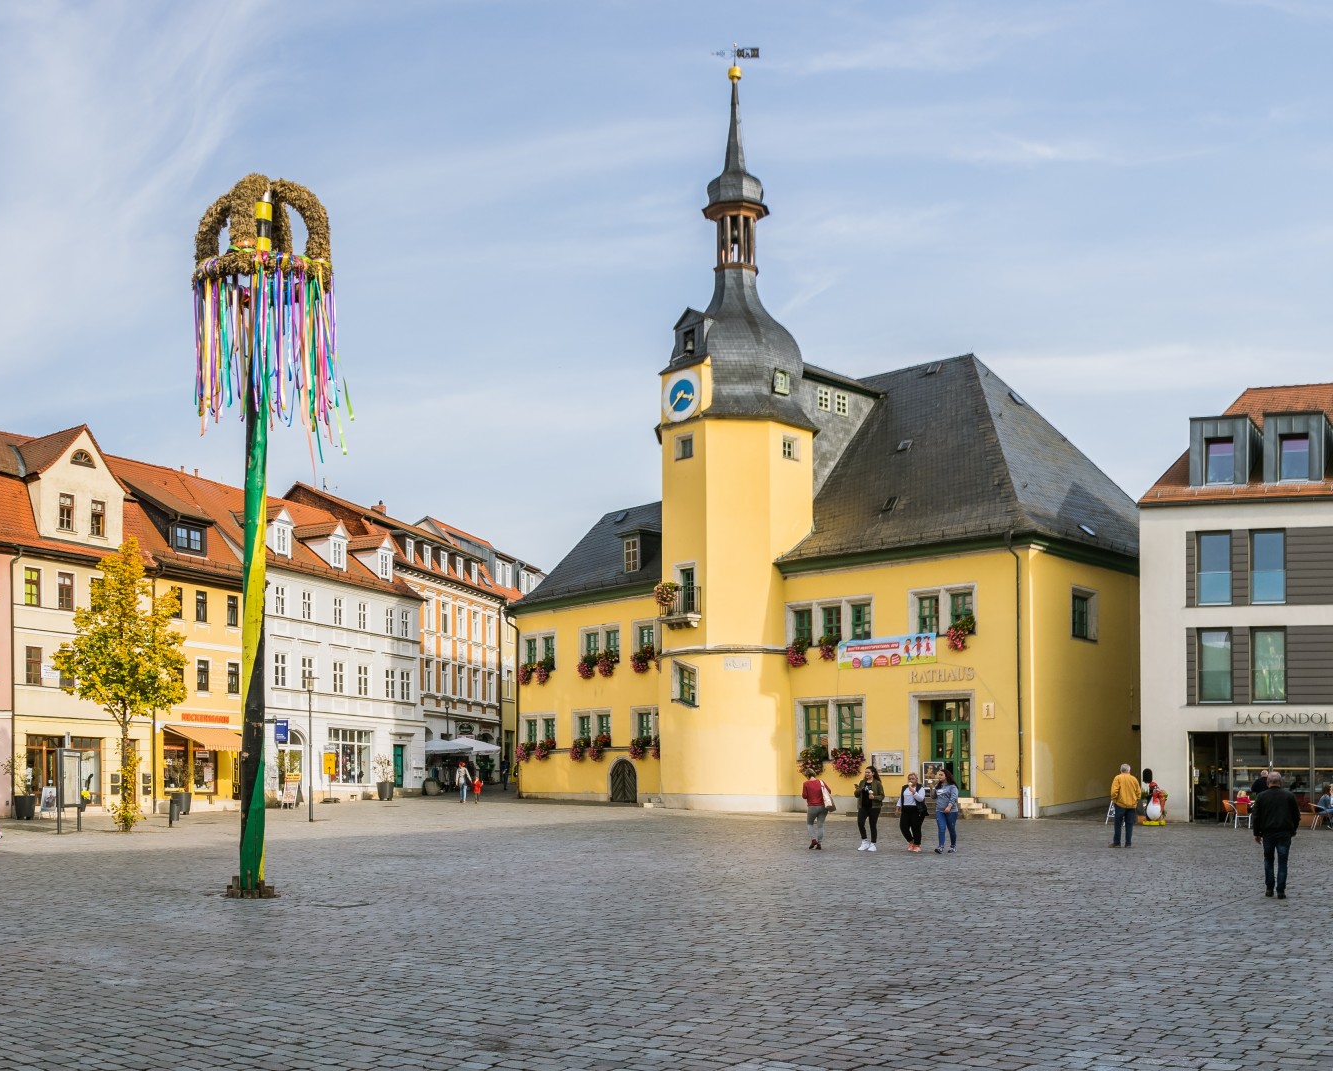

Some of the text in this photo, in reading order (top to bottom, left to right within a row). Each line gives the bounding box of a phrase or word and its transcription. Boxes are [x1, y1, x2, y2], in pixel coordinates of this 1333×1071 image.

[909, 667, 974, 684] RATHAUS
[1236, 711, 1333, 725] LA GONDOL
